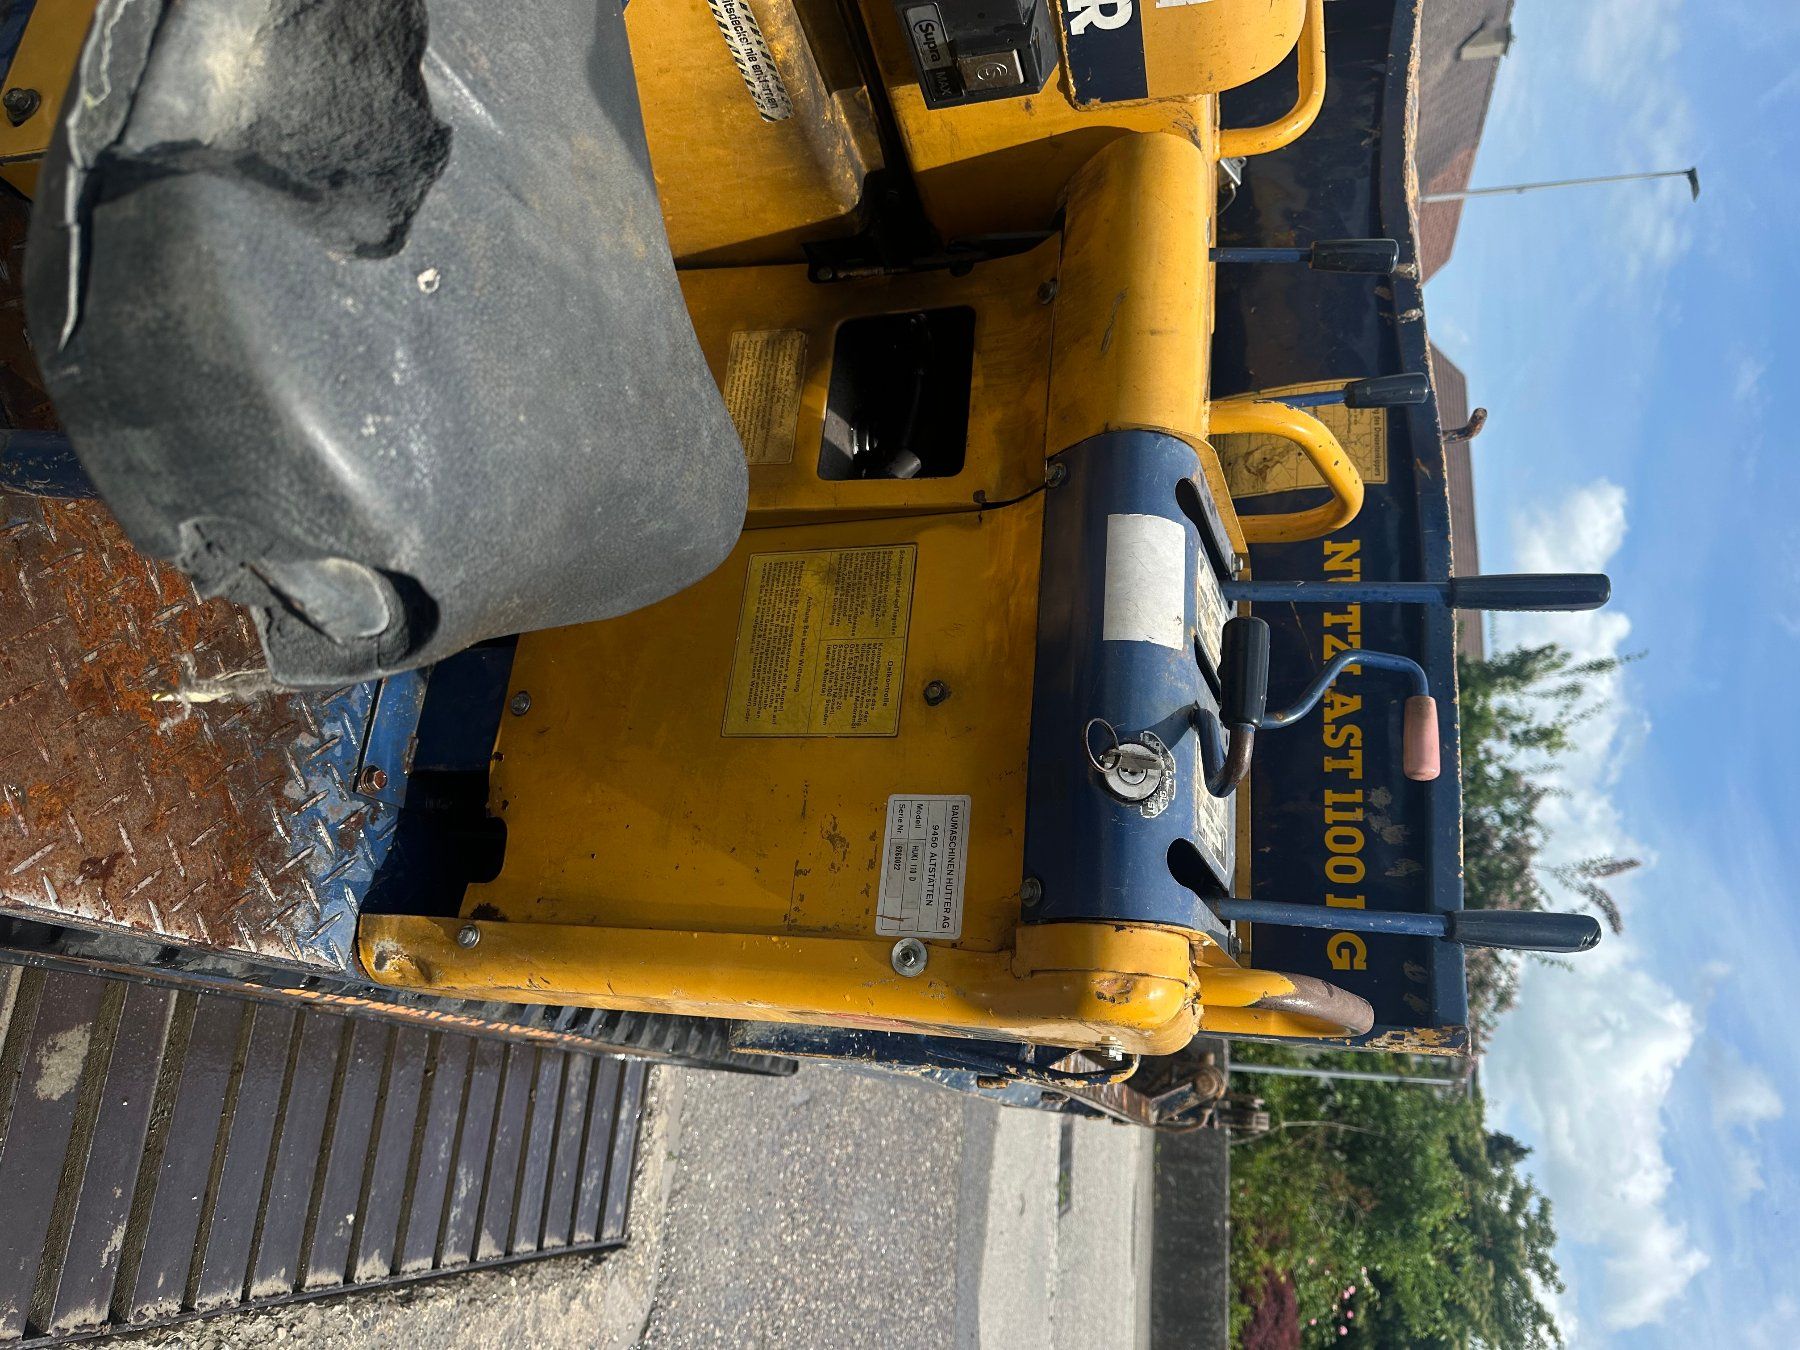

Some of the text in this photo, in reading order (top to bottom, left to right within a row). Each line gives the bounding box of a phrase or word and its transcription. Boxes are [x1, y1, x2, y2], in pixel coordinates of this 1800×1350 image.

[722, 0, 750, 45] itsdeckel
[744, 48, 757, 62] nie
[919, 23, 940, 62] Supra
[936, 72, 952, 96] MAX
[794, 596, 813, 693] Achtung Bei kalter Witterung
[829, 644, 838, 669] Danach
[839, 644, 849, 682] Oelwechsel
[864, 643, 872, 662] Motor
[874, 643, 883, 685] Kontrollieren
[827, 671, 835, 684] Alle
[883, 661, 893, 707] Oelkontrolle
[822, 699, 831, 726] Stunden
[851, 696, 860, 729] Motorenöl
[898, 804, 906, 823] Serie
[914, 804, 923, 828] Modell
[1324, 789, 1366, 884] 1100
[925, 825, 939, 906] 9450 ALTSTÄTTEN
[942, 805, 959, 929] BAUMASCHINEN HUTTER AG
